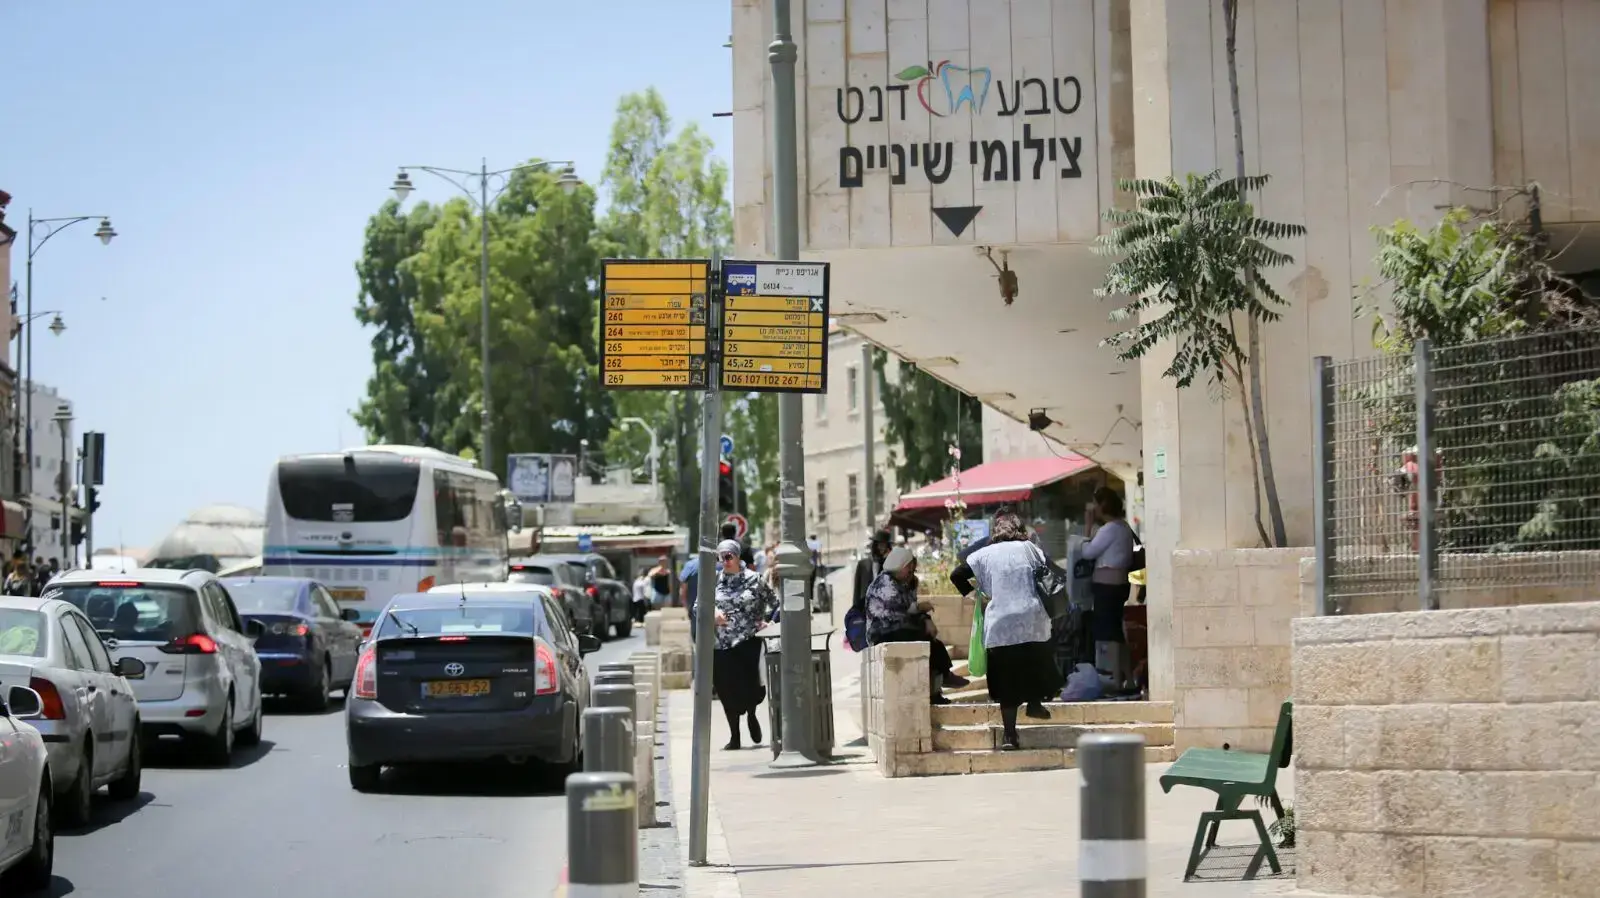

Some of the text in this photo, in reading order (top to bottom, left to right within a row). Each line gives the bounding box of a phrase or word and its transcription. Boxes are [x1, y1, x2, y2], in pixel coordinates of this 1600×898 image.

[837, 76, 1082, 124] טבע דנט
[839, 124, 1082, 188] צילומי שיניים
[610, 298, 626, 306] 270
[729, 299, 734, 307] 7
[608, 313, 623, 321] 260
[608, 328, 623, 336] 264
[728, 329, 733, 338] 9
[608, 343, 622, 352] 265
[728, 344, 738, 352] 25
[607, 359, 622, 367] 262
[608, 374, 624, 383] 269
[661, 374, 672, 382] אל
[727, 374, 741, 383] 106
[746, 375, 760, 384] 107
[764, 376, 780, 384] 102
[782, 376, 799, 385] 267
